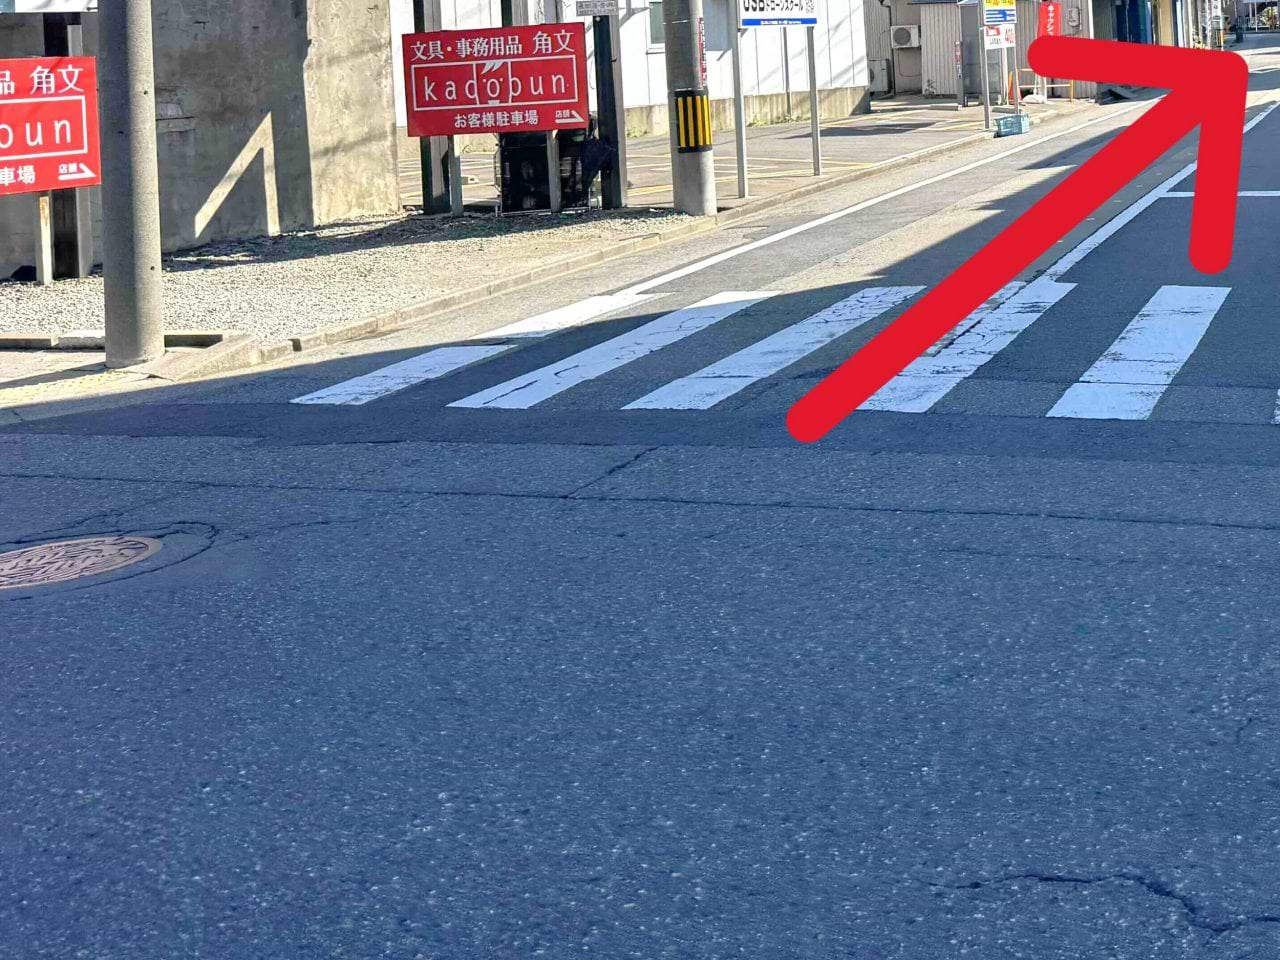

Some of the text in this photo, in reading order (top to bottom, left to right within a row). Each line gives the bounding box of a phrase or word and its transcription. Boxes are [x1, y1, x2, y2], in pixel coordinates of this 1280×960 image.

[765, 0, 803, 12] ドローンスクール
[410, 29, 575, 62] 文具・事務用品 角文
[30, 65, 84, 95] 角文
[453, 109, 539, 129] お客様駐車場
